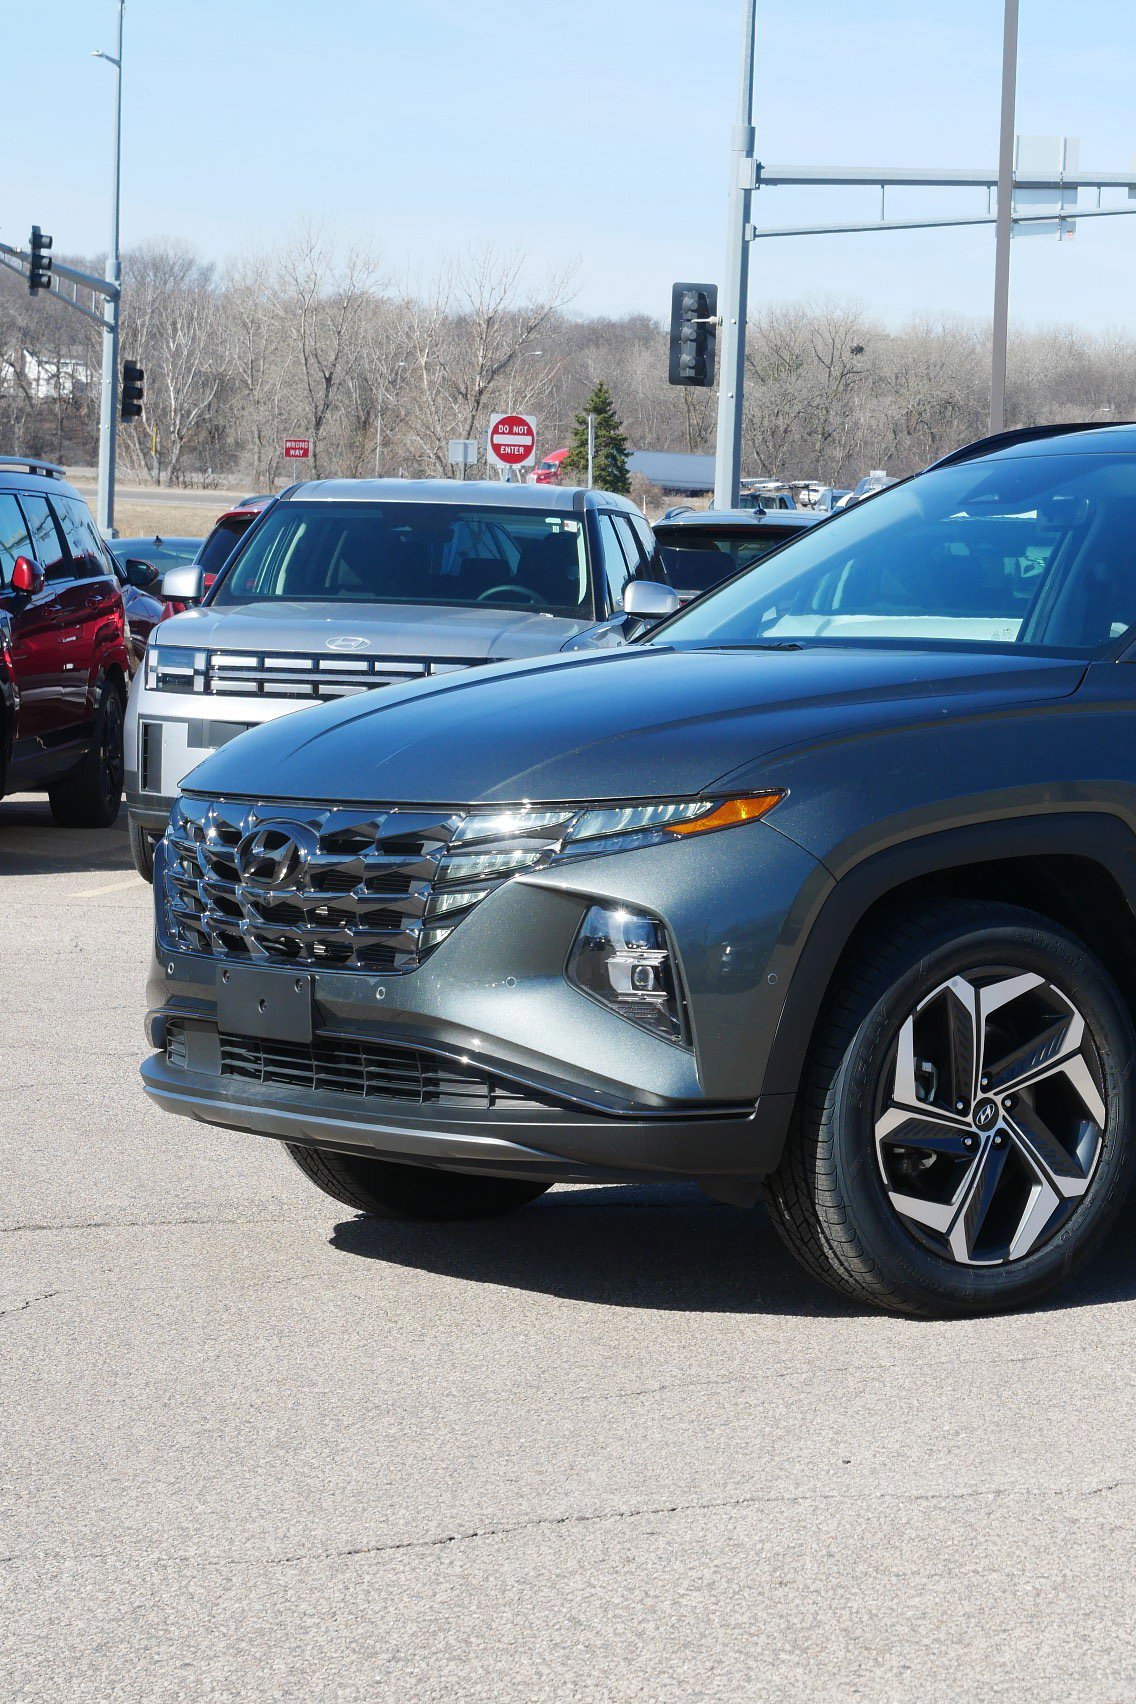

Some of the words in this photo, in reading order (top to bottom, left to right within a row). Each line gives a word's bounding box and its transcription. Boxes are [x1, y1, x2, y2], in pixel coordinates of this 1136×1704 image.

[498, 425, 509, 433] DO
[513, 425, 528, 434] NOT
[286, 441, 309, 449] WRONG
[500, 446, 524, 455] ENTER
